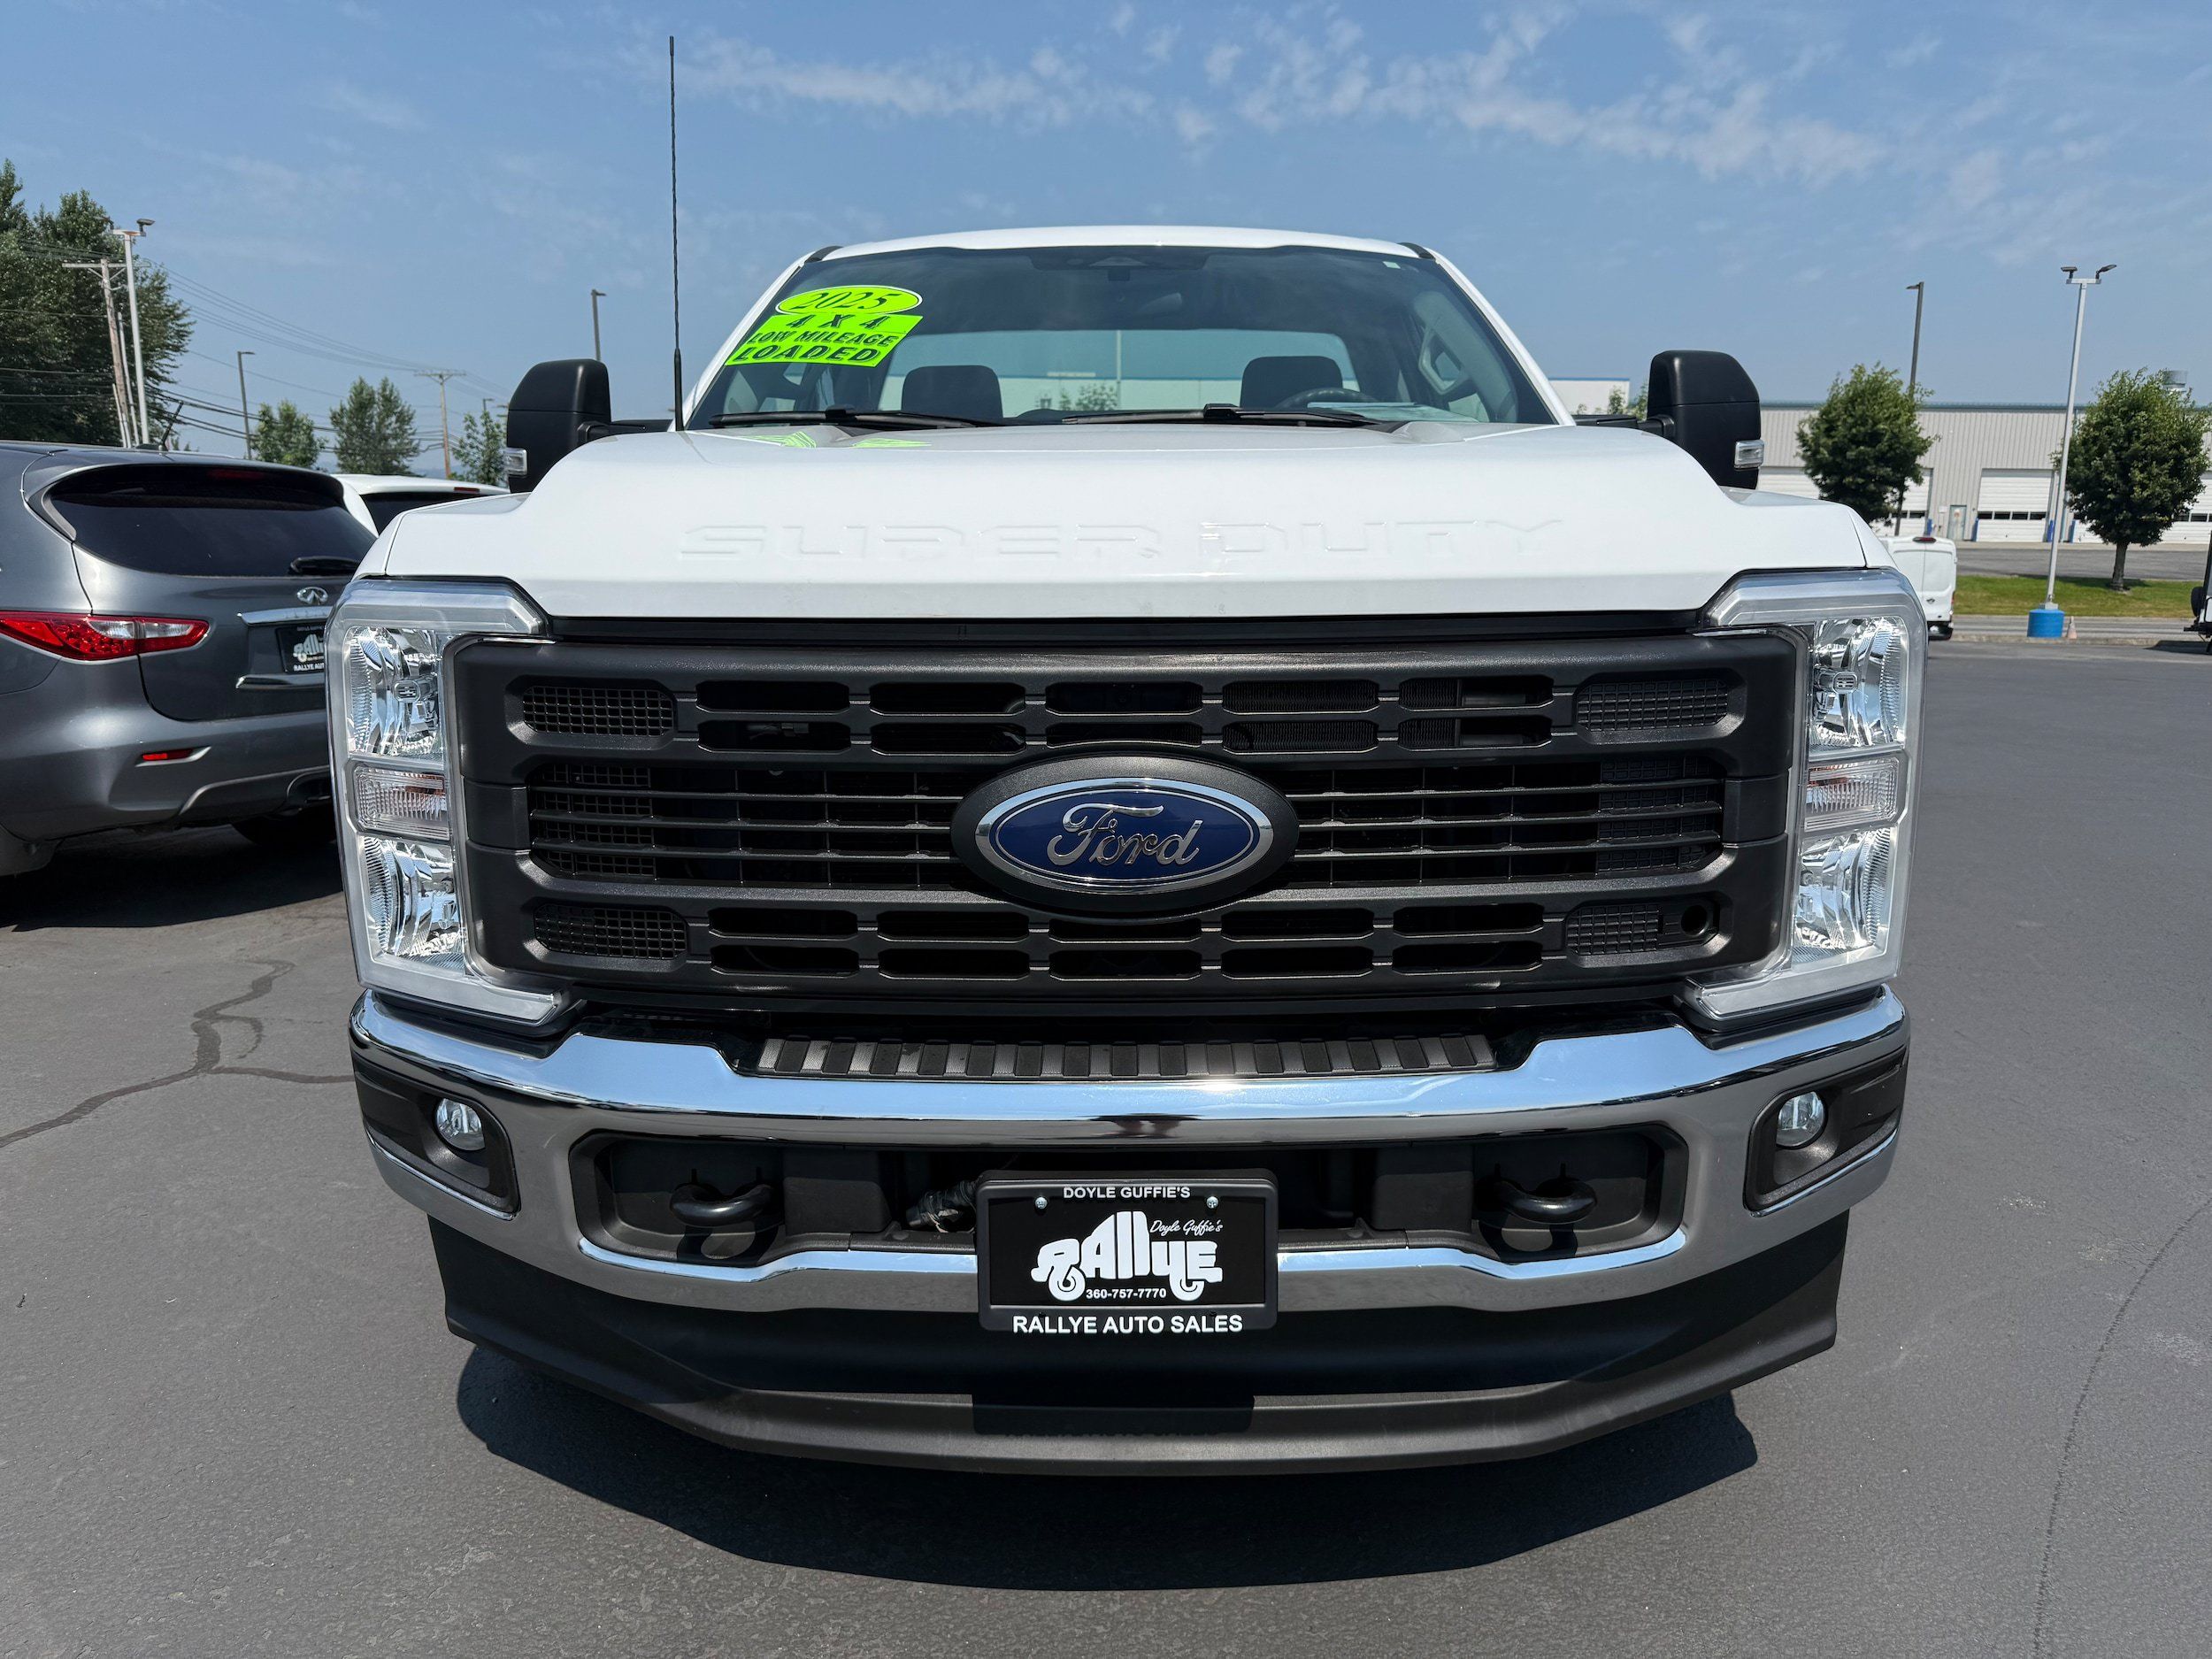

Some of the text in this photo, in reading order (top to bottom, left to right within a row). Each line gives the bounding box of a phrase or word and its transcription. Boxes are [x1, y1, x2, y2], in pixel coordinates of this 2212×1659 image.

[790, 291, 902, 310] 2025
[747, 331, 899, 347] LOW MILEAGE
[733, 344, 882, 363] LOADED
[678, 518, 1564, 560] SUPER DUTY
[1048, 803, 1202, 866] Ford
[1064, 1187, 1191, 1199] DOYLE GUFFIE'S
[1149, 1218, 1224, 1237] Doyle Guffie's
[1086, 1287, 1167, 1300] 360-757-7770
[1012, 1314, 1243, 1334] RALLYE AUTO SALES
